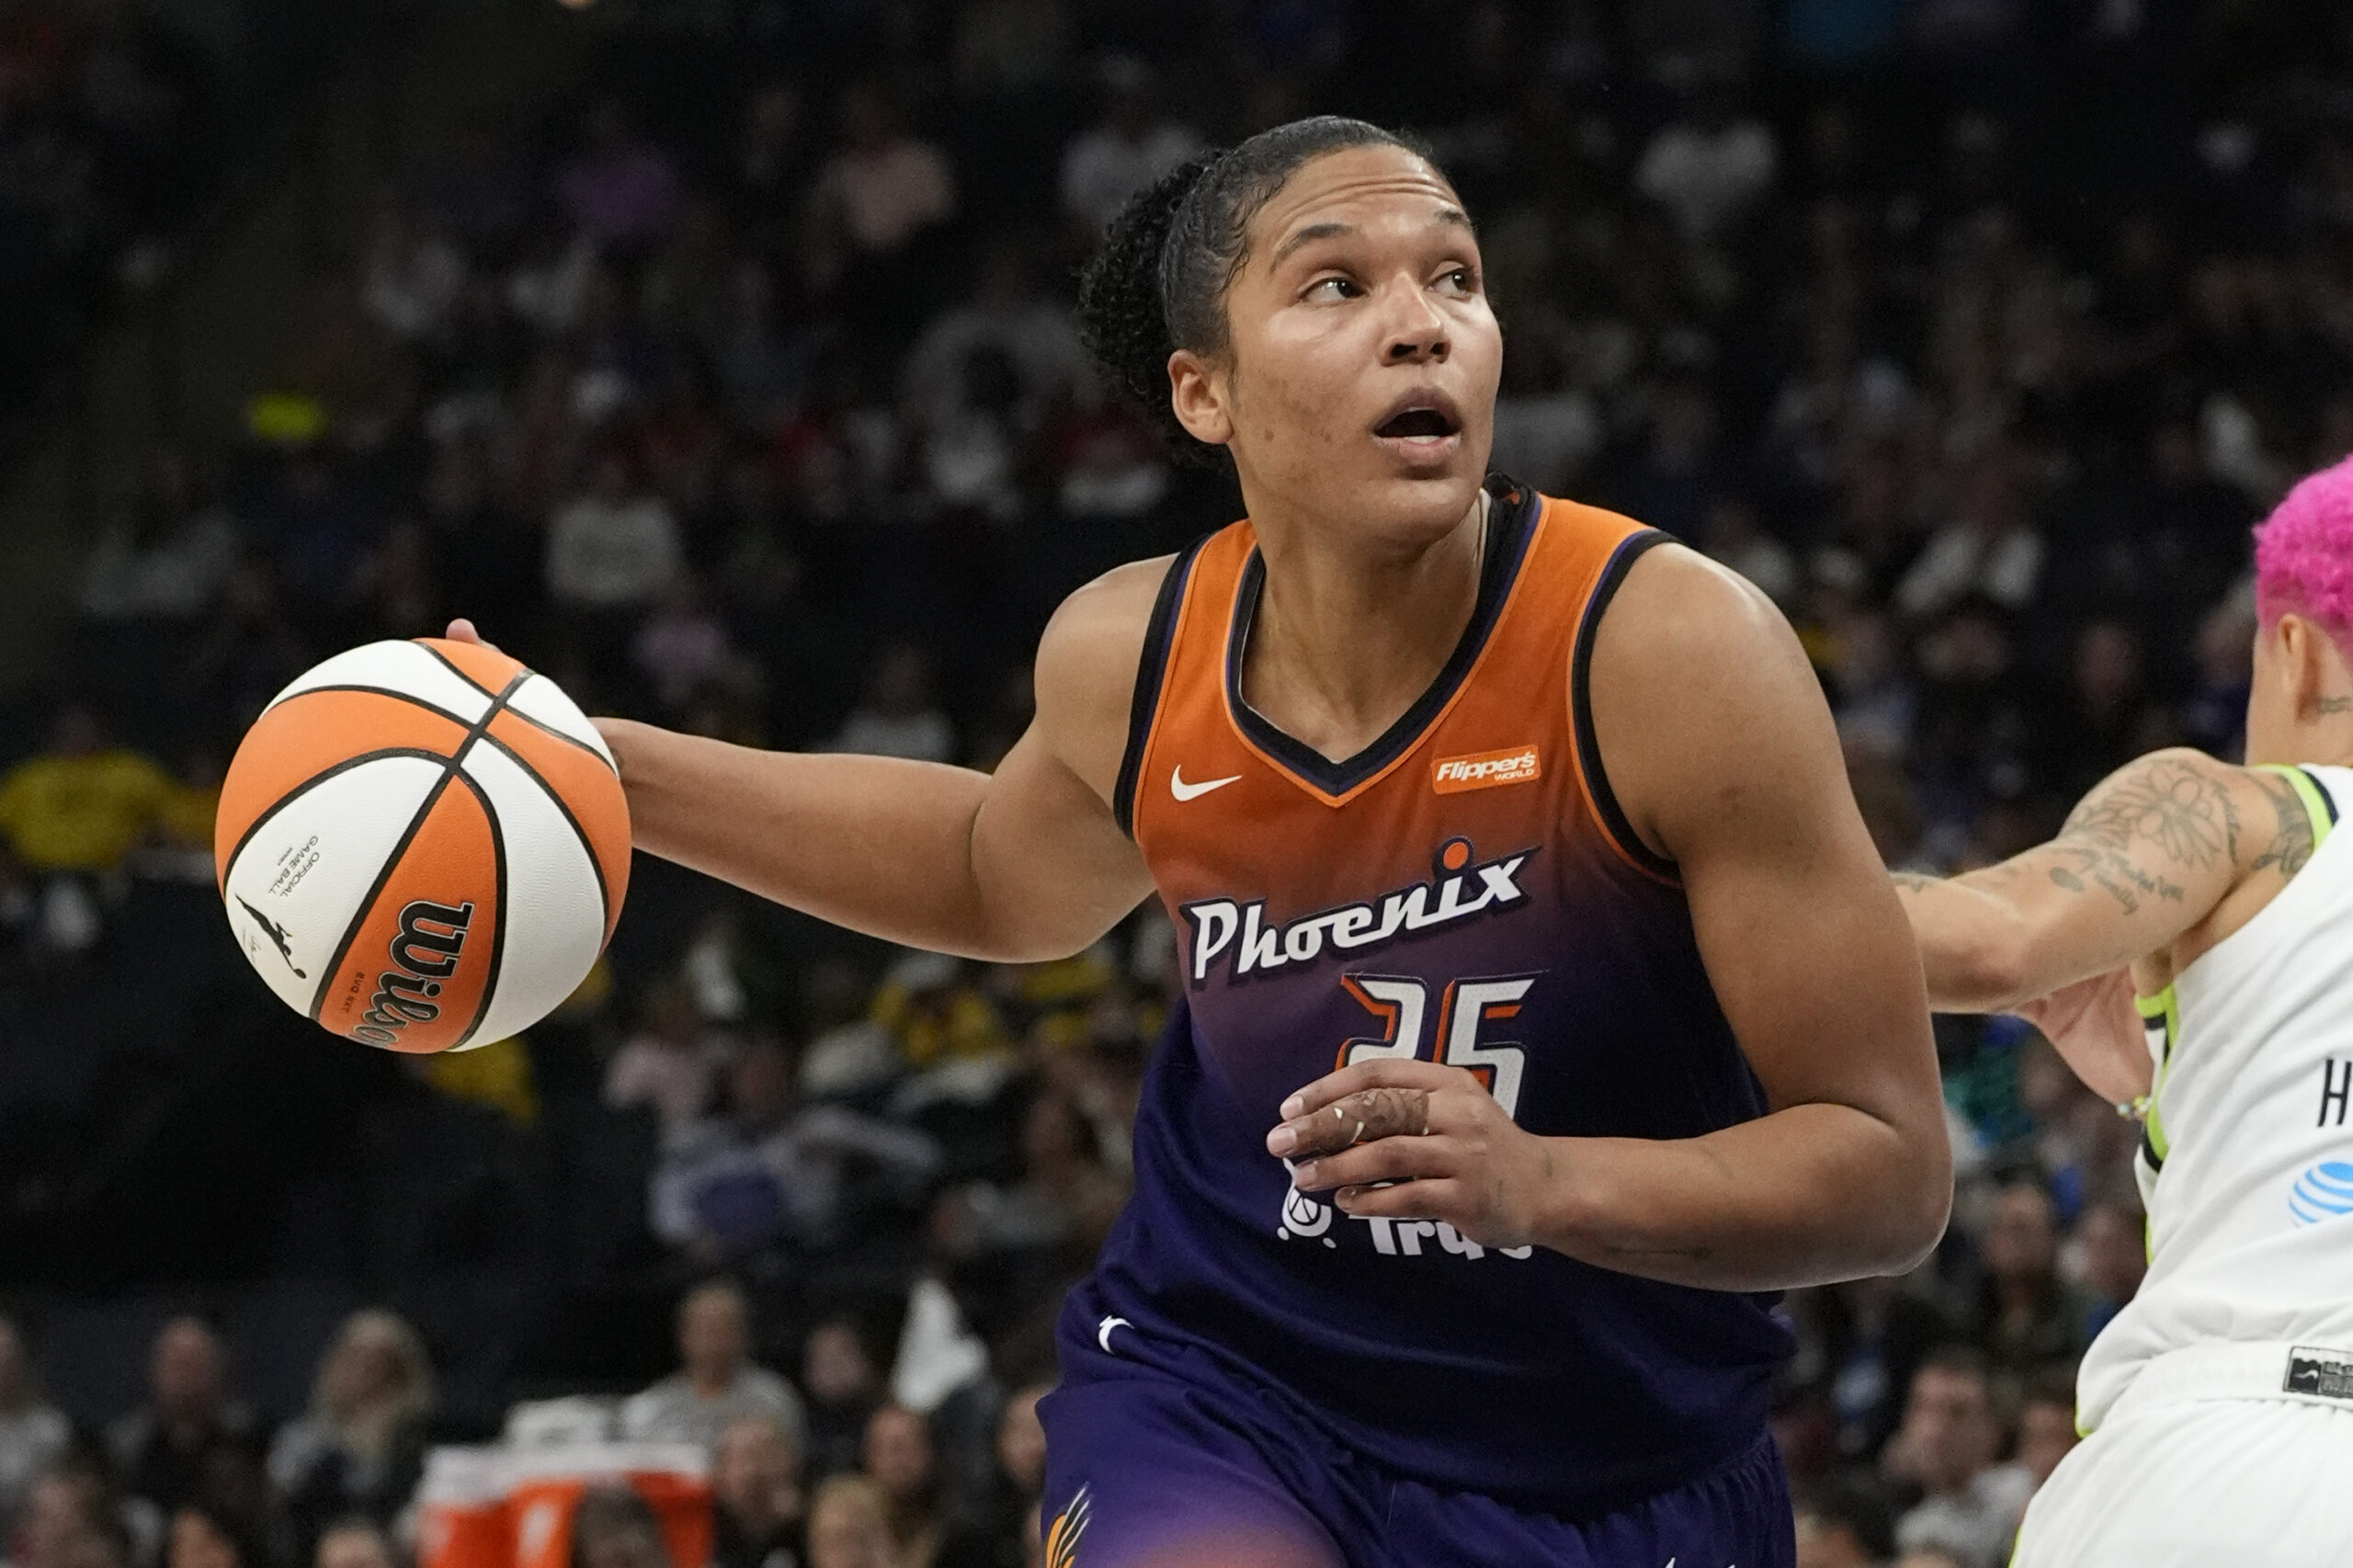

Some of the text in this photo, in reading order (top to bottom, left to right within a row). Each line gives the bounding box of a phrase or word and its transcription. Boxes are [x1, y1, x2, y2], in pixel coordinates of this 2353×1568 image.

[1494, 768, 1534, 781] WORLD
[279, 852, 320, 897] OFFICIAL
[289, 835, 318, 870] GAME
[268, 868, 291, 894] BALL
[1180, 837, 1540, 985] Phoenix
[347, 900, 475, 1047] Wilso
[1335, 971, 1540, 1121] 25
[1347, 1213, 1533, 1260] Tru
